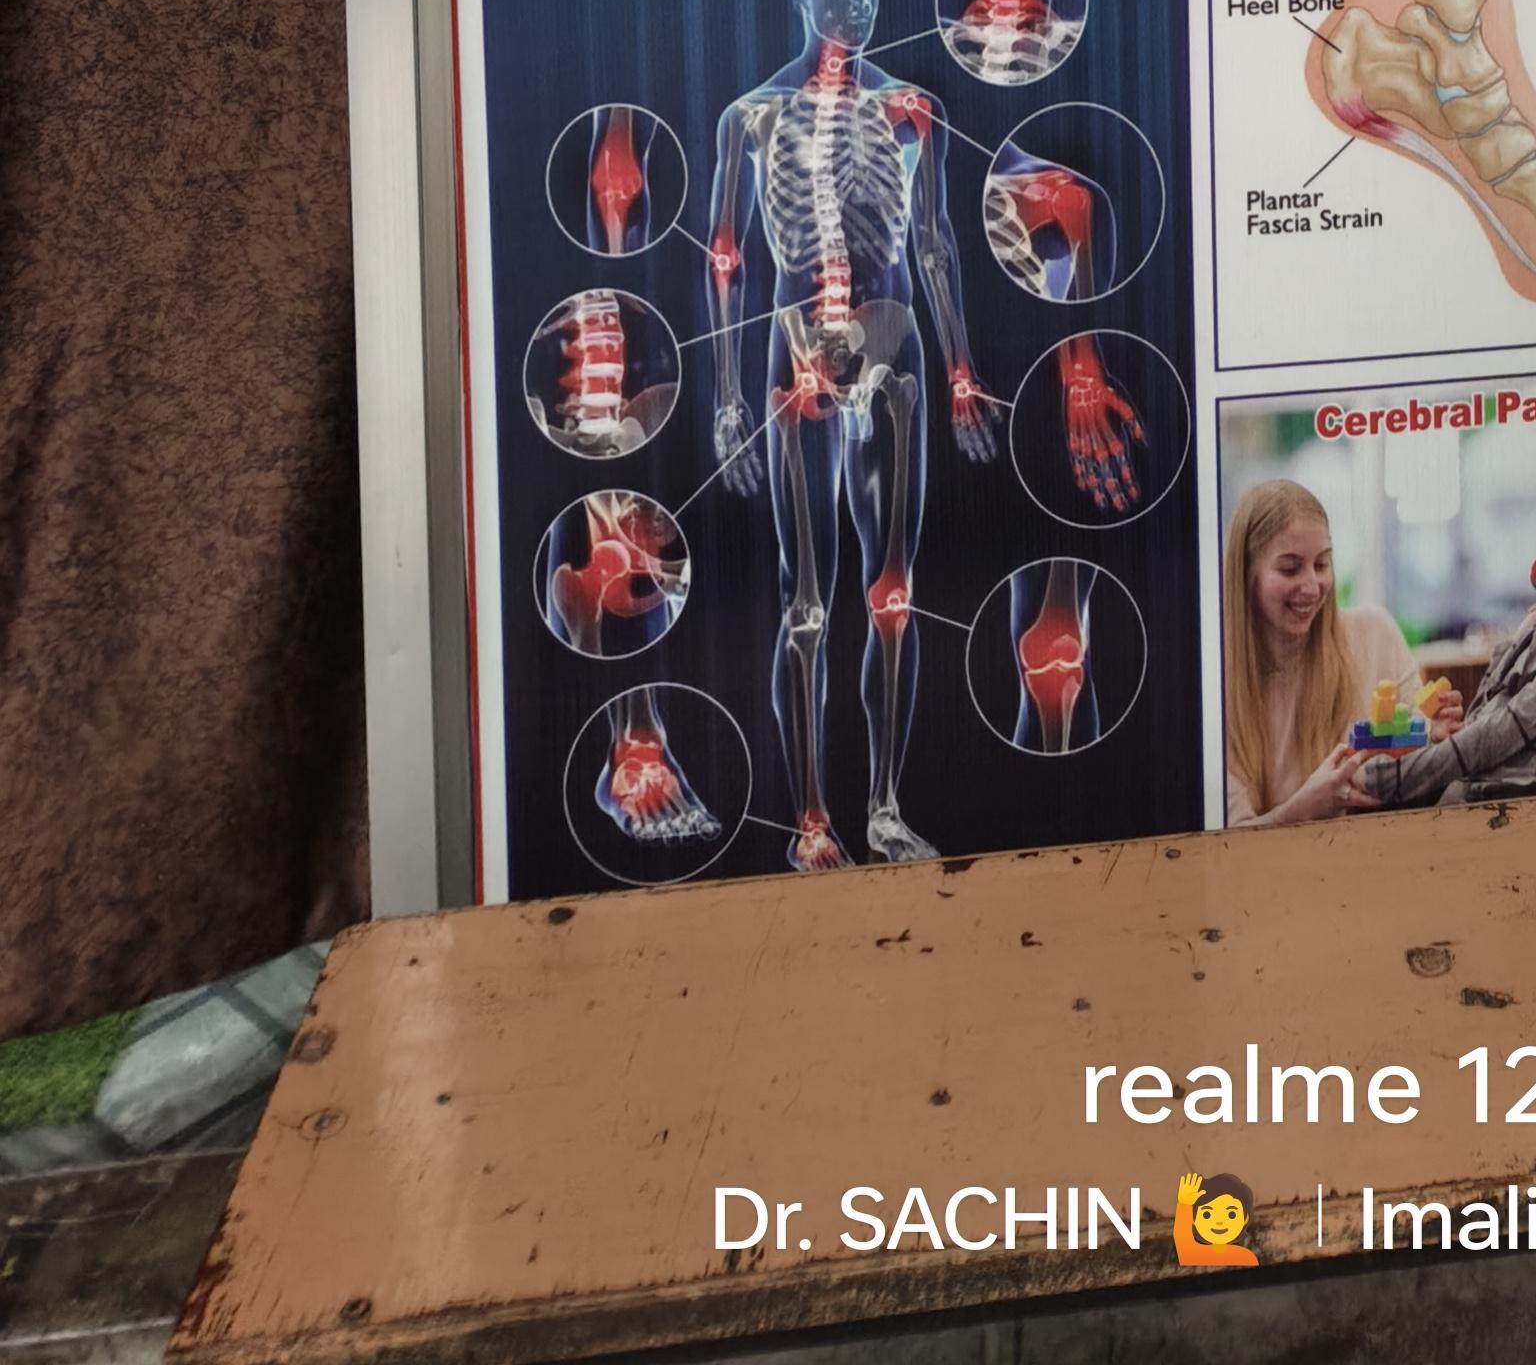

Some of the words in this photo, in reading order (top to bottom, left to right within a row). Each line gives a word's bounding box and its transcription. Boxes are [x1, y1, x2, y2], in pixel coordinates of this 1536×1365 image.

[1247, 189, 1325, 212] Plantar
[1247, 211, 1312, 236] Fascia
[1319, 207, 1384, 232] Strain
[1314, 393, 1485, 440] Cerebral
